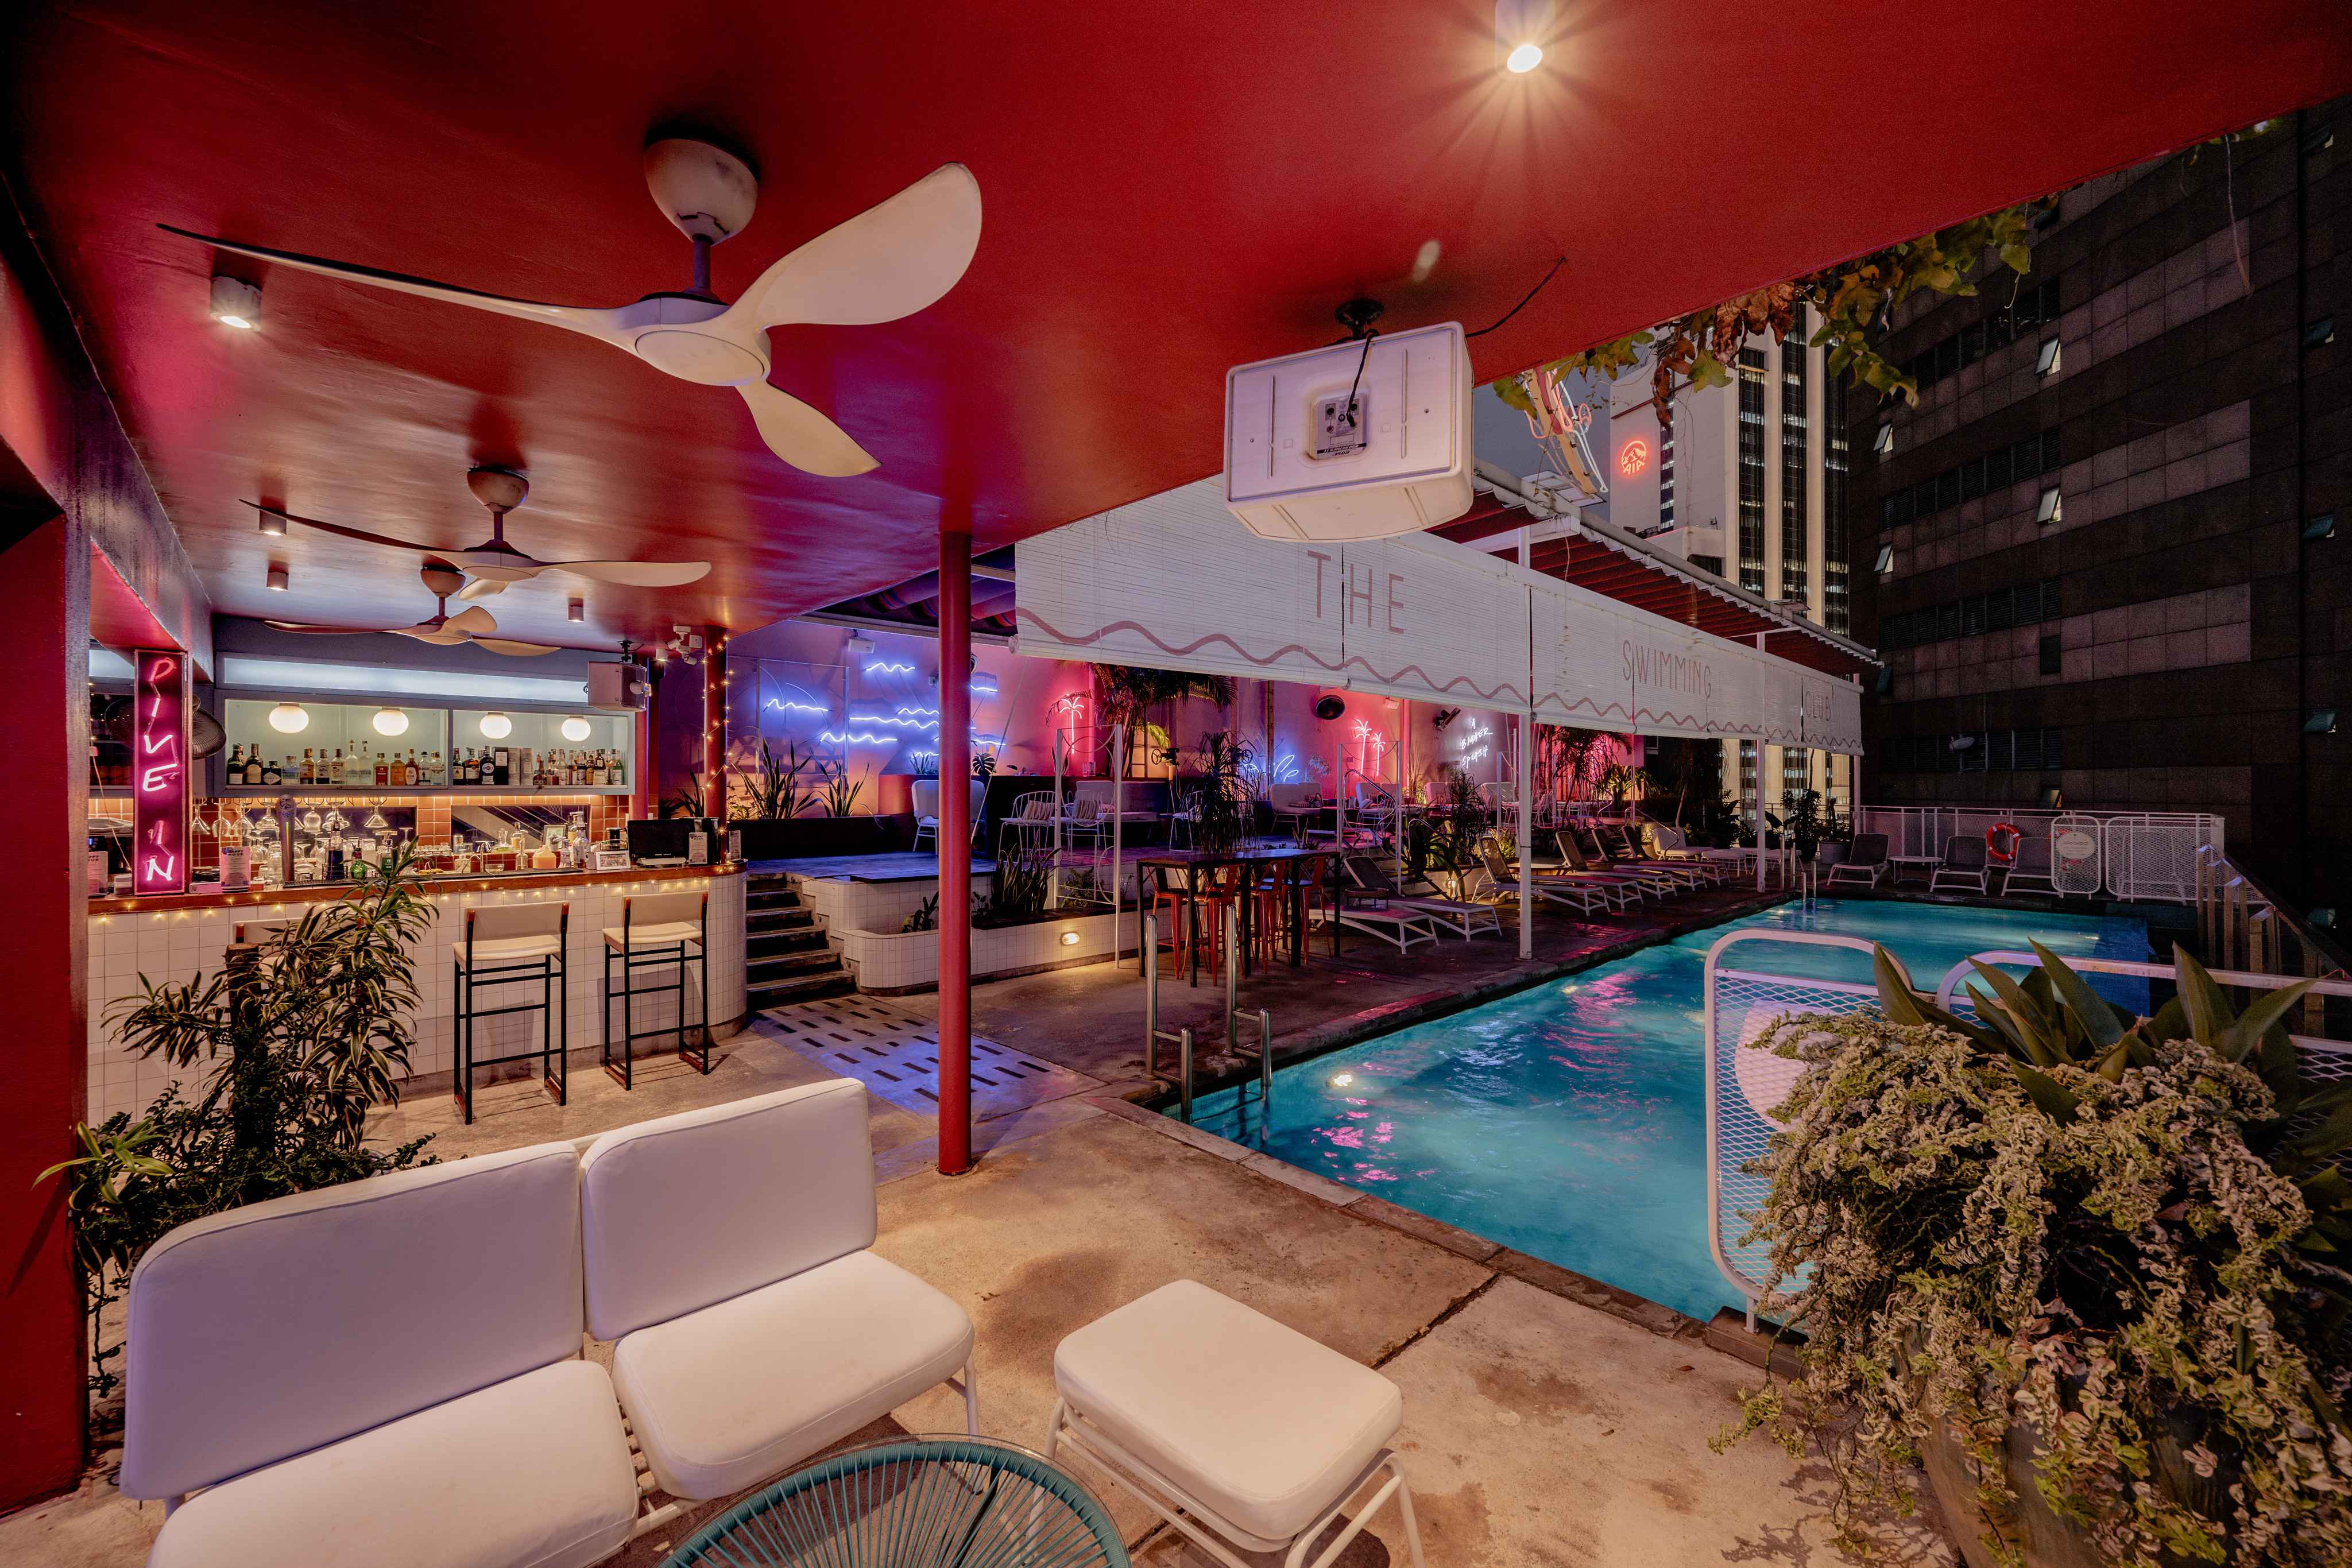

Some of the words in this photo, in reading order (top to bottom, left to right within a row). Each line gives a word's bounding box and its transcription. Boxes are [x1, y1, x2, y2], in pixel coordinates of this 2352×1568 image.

[1623, 460, 1645, 474] AIA
[1307, 550, 1405, 634] THE
[1623, 640, 1712, 699] SWIMMING
[1805, 691, 1832, 722] CLUB
[142, 657, 177, 792] DIVE
[1471, 718, 1476, 729] A
[1462, 745, 1488, 769] SPLASH
[146, 820, 174, 881] IN
